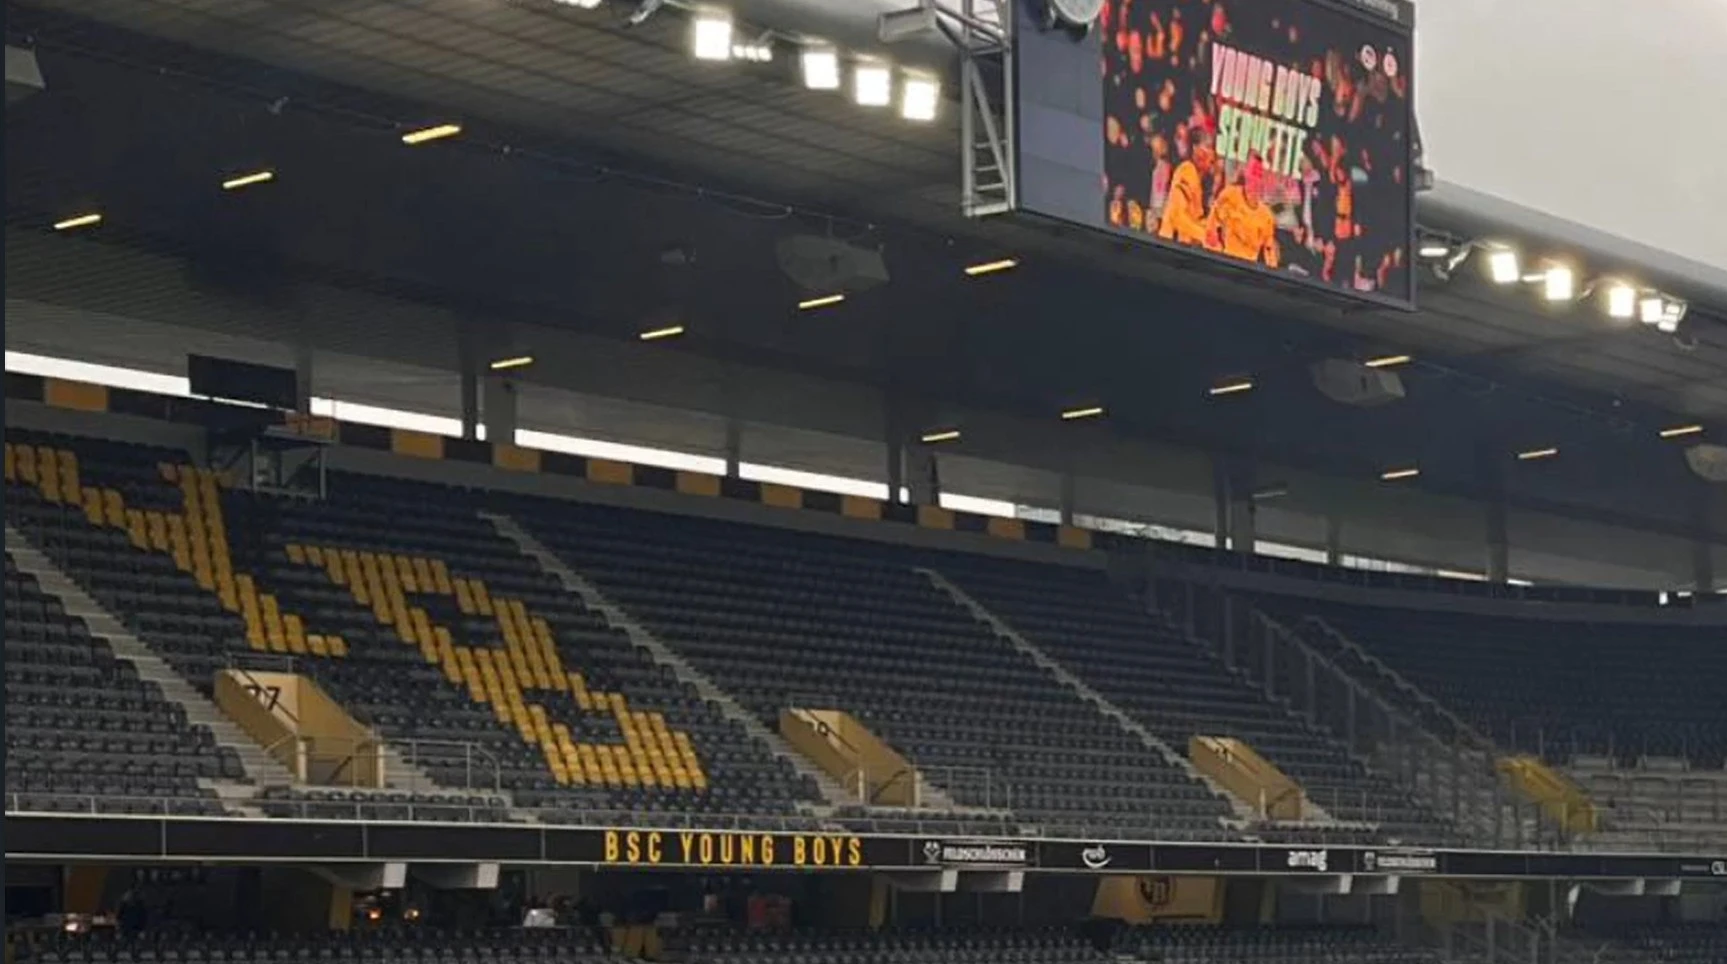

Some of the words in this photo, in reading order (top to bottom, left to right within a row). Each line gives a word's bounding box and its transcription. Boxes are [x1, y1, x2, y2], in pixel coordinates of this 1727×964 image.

[604, 830, 662, 863] BSC
[680, 832, 775, 865] YOUNG
[793, 835, 862, 866] BOYS
